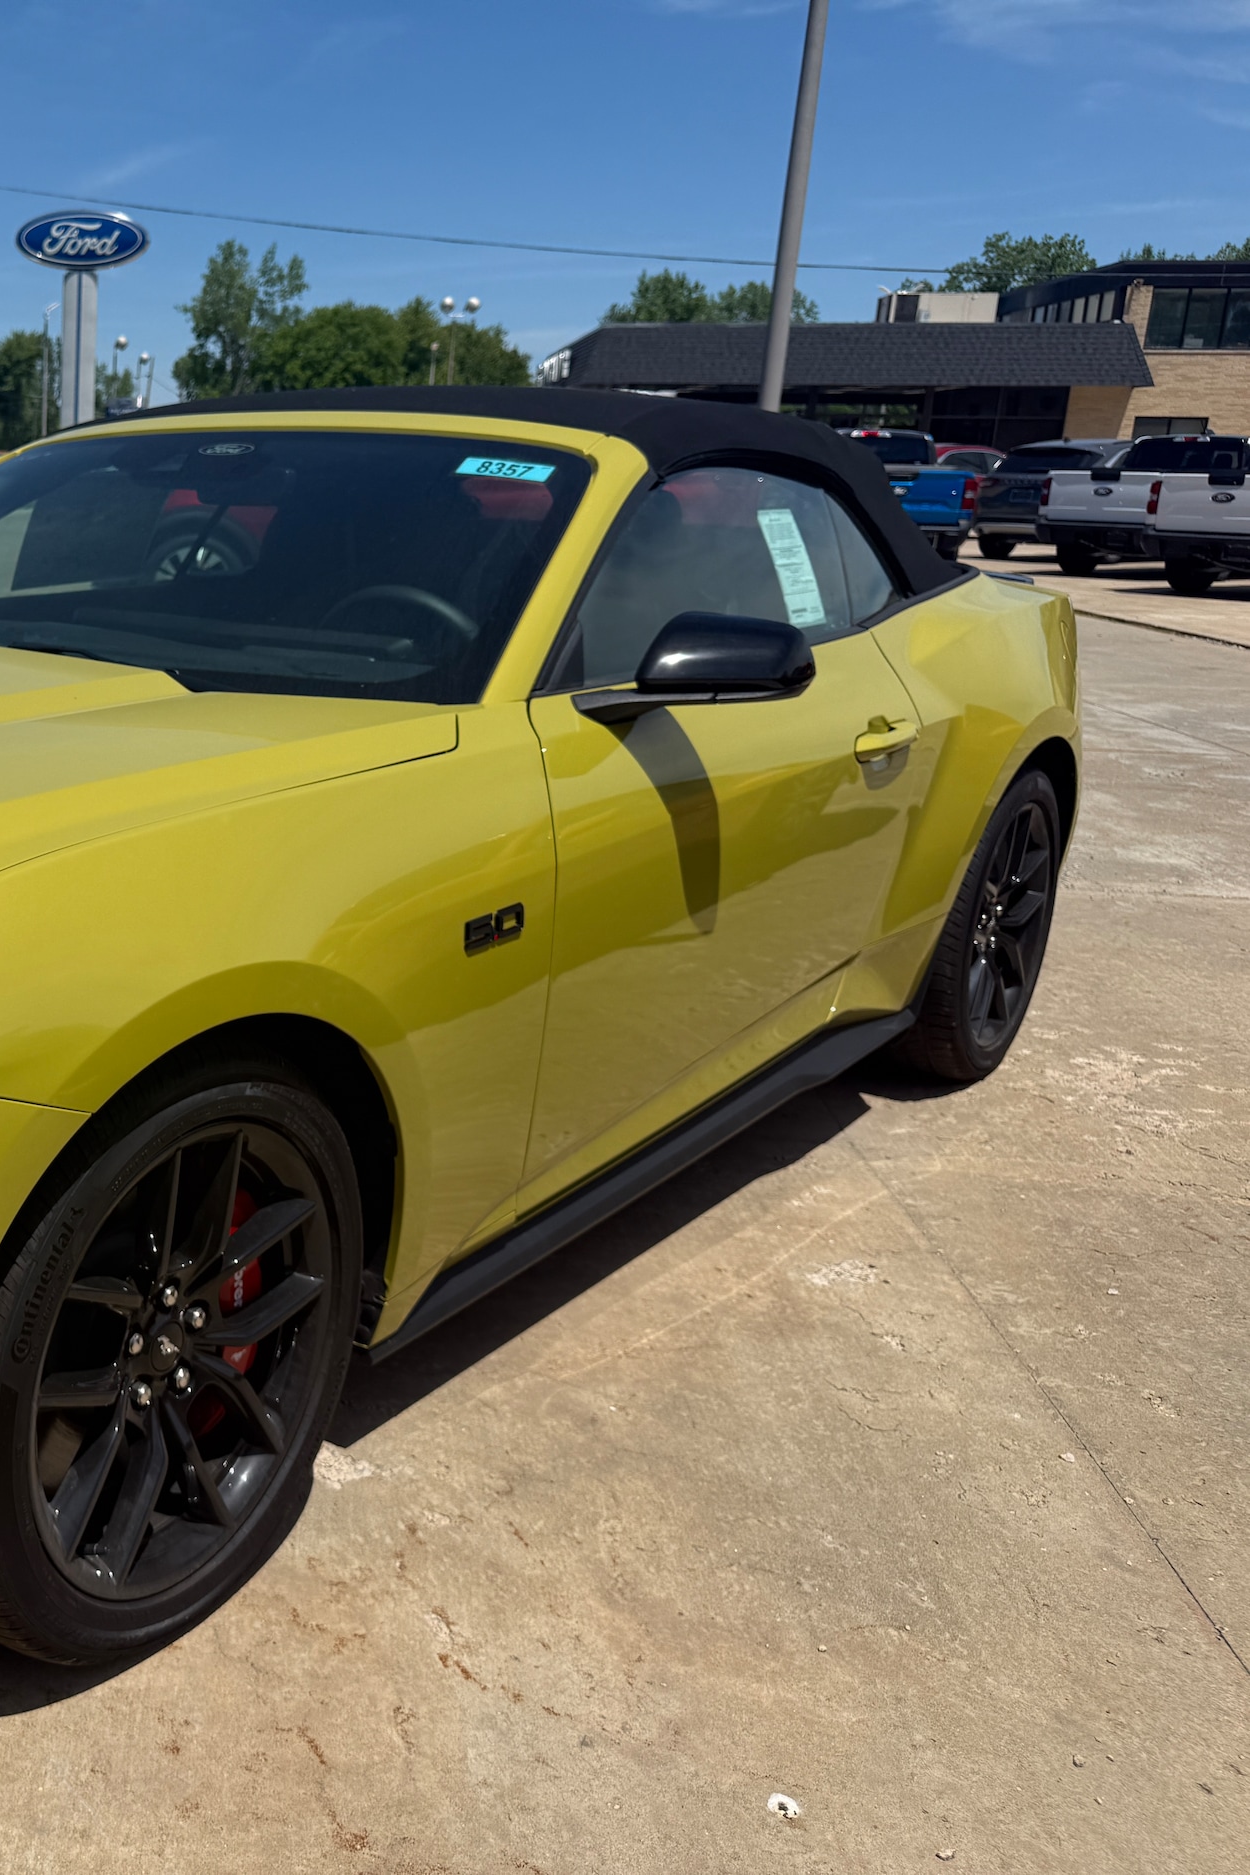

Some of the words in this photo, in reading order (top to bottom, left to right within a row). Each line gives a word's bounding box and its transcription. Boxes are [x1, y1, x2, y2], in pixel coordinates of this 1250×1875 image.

[42, 221, 121, 256] Ford
[476, 461, 534, 478] 8357
[464, 902, 524, 952] 5.0
[11, 1221, 75, 1363] Continental
